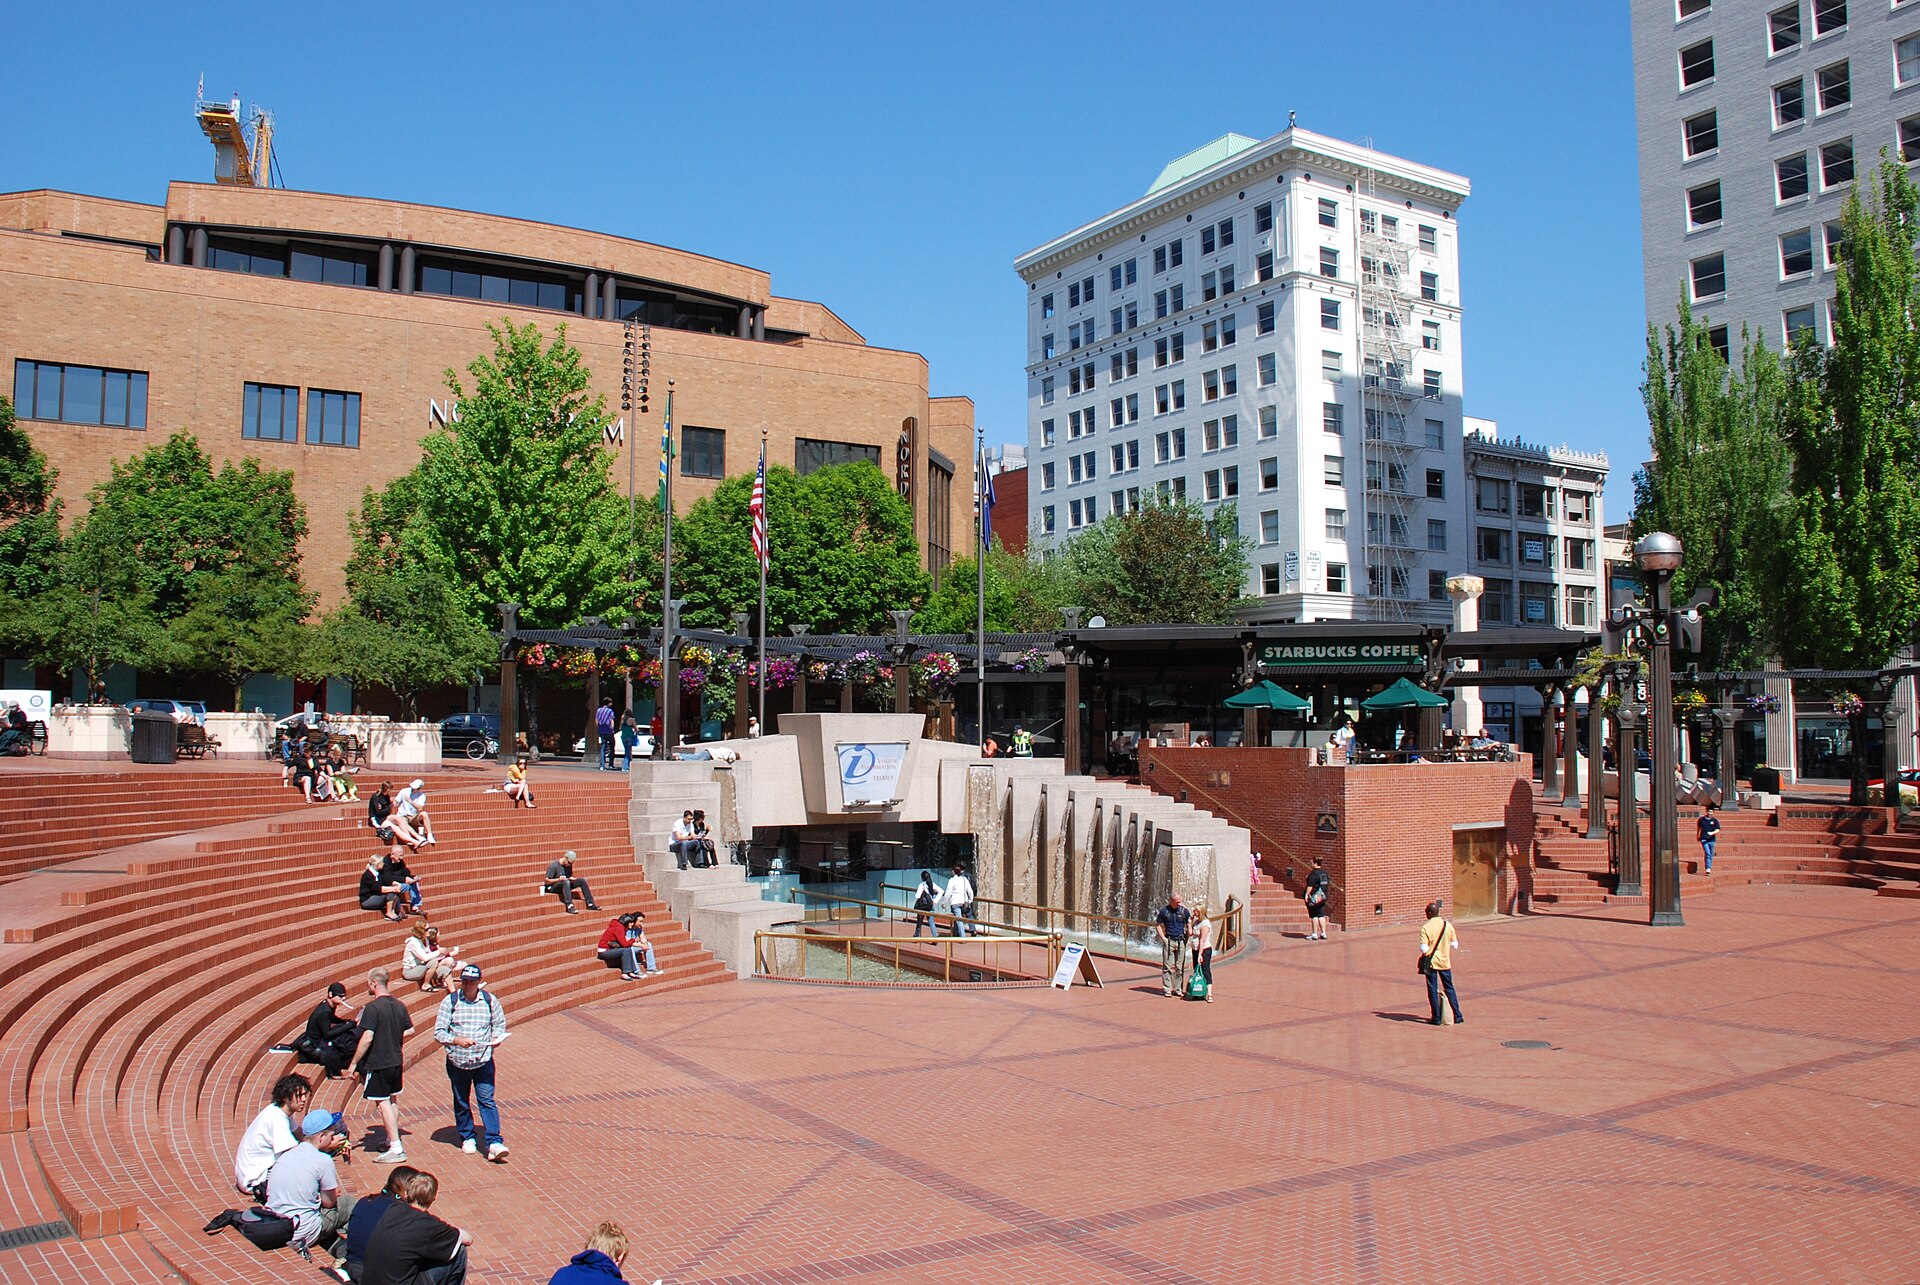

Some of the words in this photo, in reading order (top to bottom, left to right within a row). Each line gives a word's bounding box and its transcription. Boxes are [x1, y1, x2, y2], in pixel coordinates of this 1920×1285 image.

[900, 429, 910, 496] NORD
[1264, 646, 1357, 658] STARBUCKS
[1360, 645, 1420, 657] COFFEE
